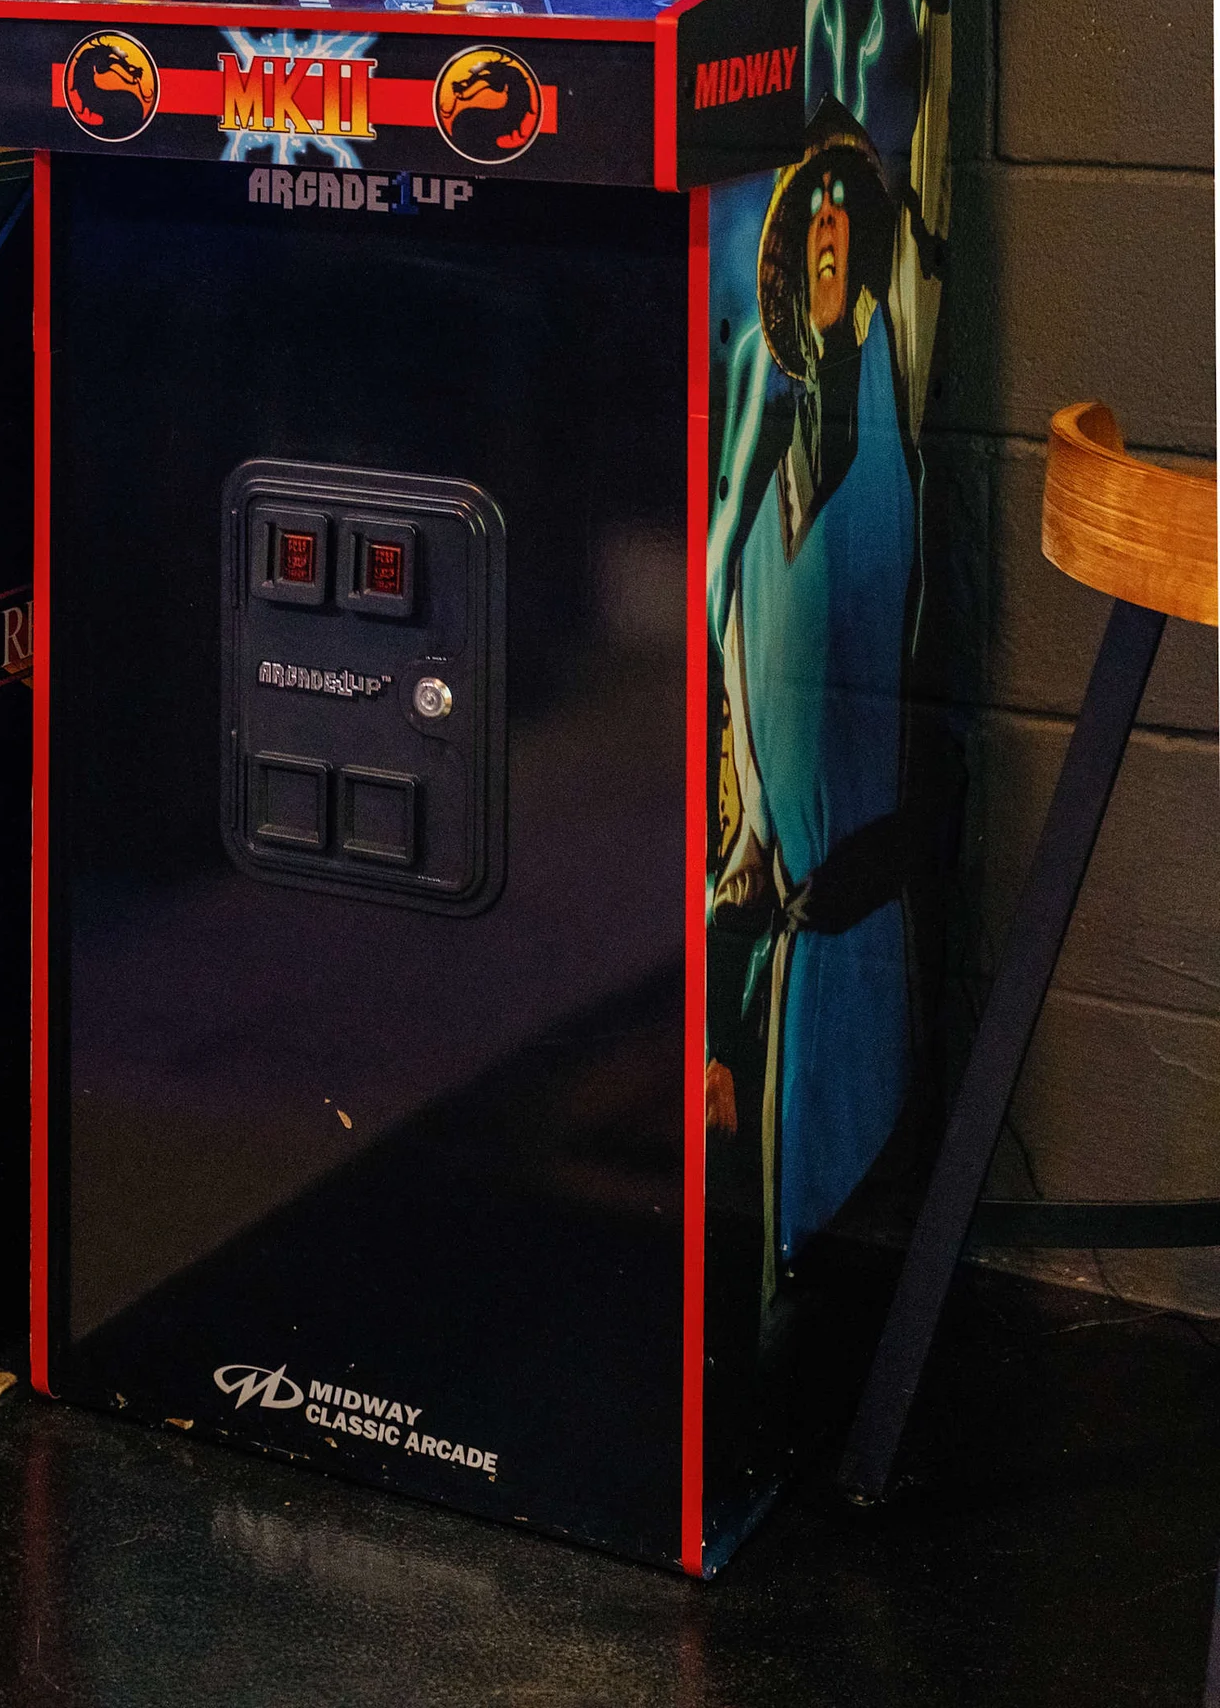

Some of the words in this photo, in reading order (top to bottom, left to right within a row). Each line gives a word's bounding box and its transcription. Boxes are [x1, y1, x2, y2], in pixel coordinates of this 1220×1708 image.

[219, 53, 377, 139] MKII
[694, 46, 798, 110] MIDWAY
[308, 1380, 422, 1426] MIDWAY
[305, 1403, 400, 1446] CLASSIC
[404, 1431, 498, 1474] ARCADE
